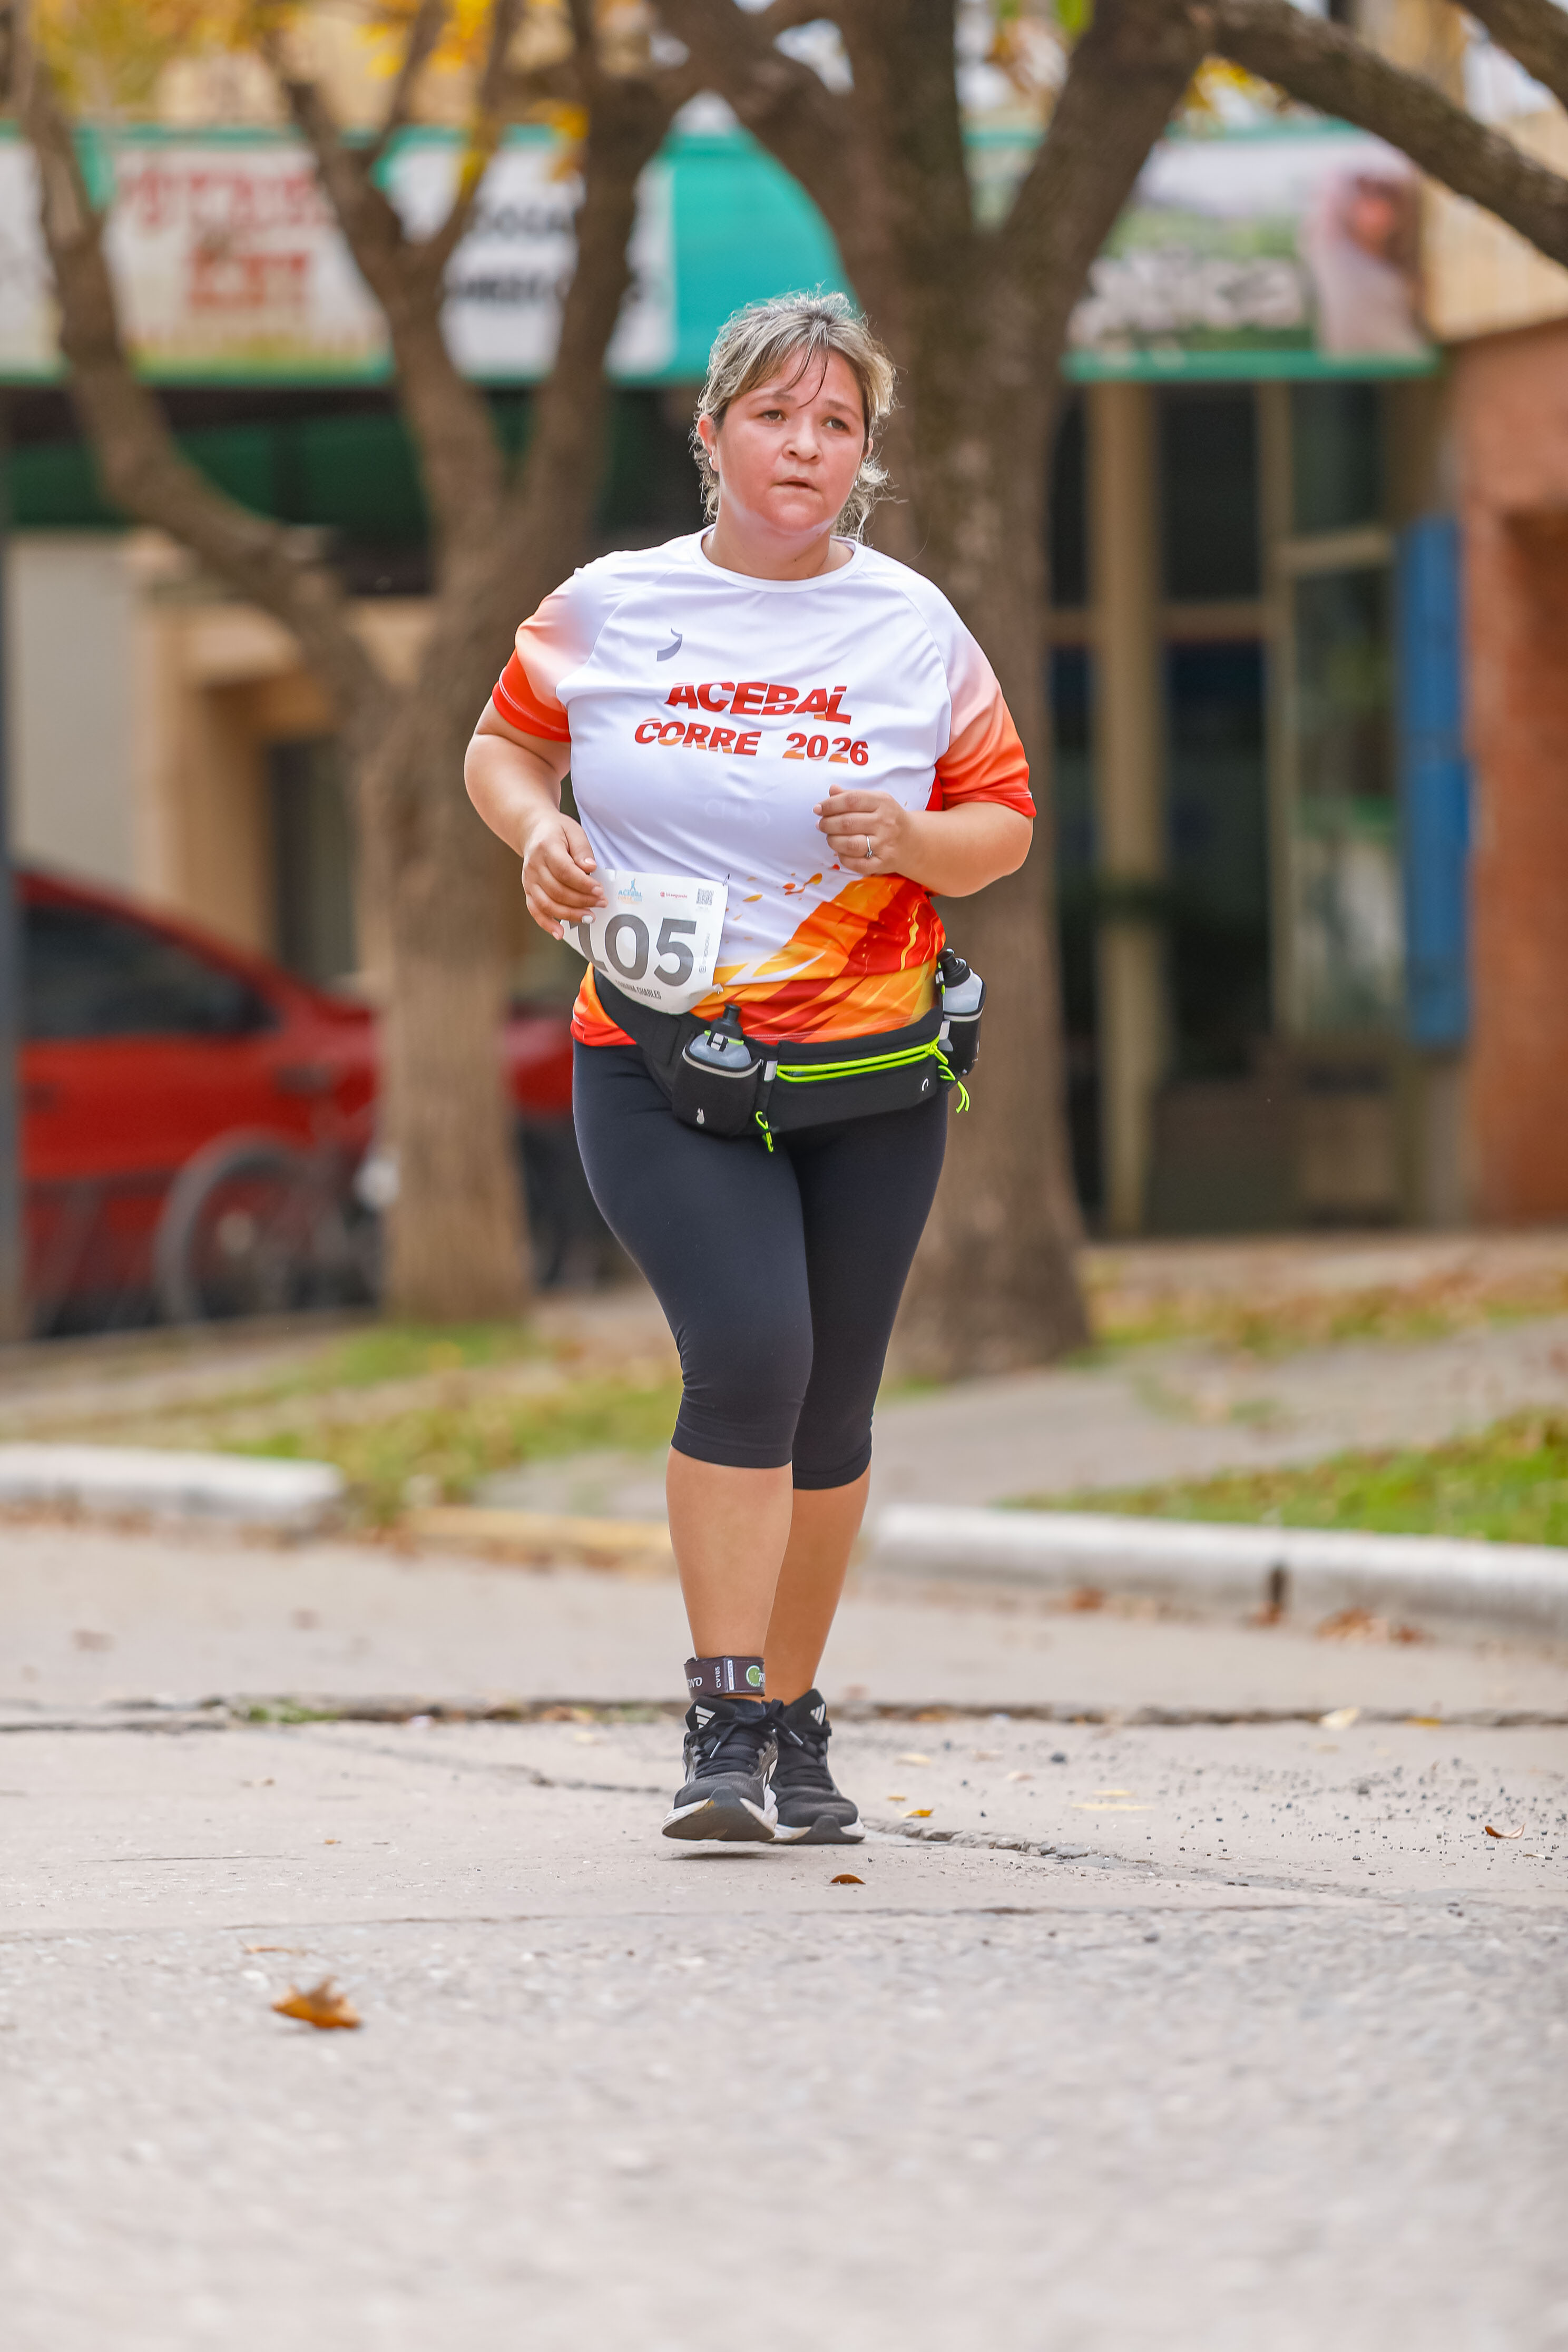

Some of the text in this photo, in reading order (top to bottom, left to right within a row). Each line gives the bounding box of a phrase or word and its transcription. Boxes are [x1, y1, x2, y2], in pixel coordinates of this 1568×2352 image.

[664, 681, 851, 725] ACEBAL
[635, 718, 869, 766] CORRE 2026
